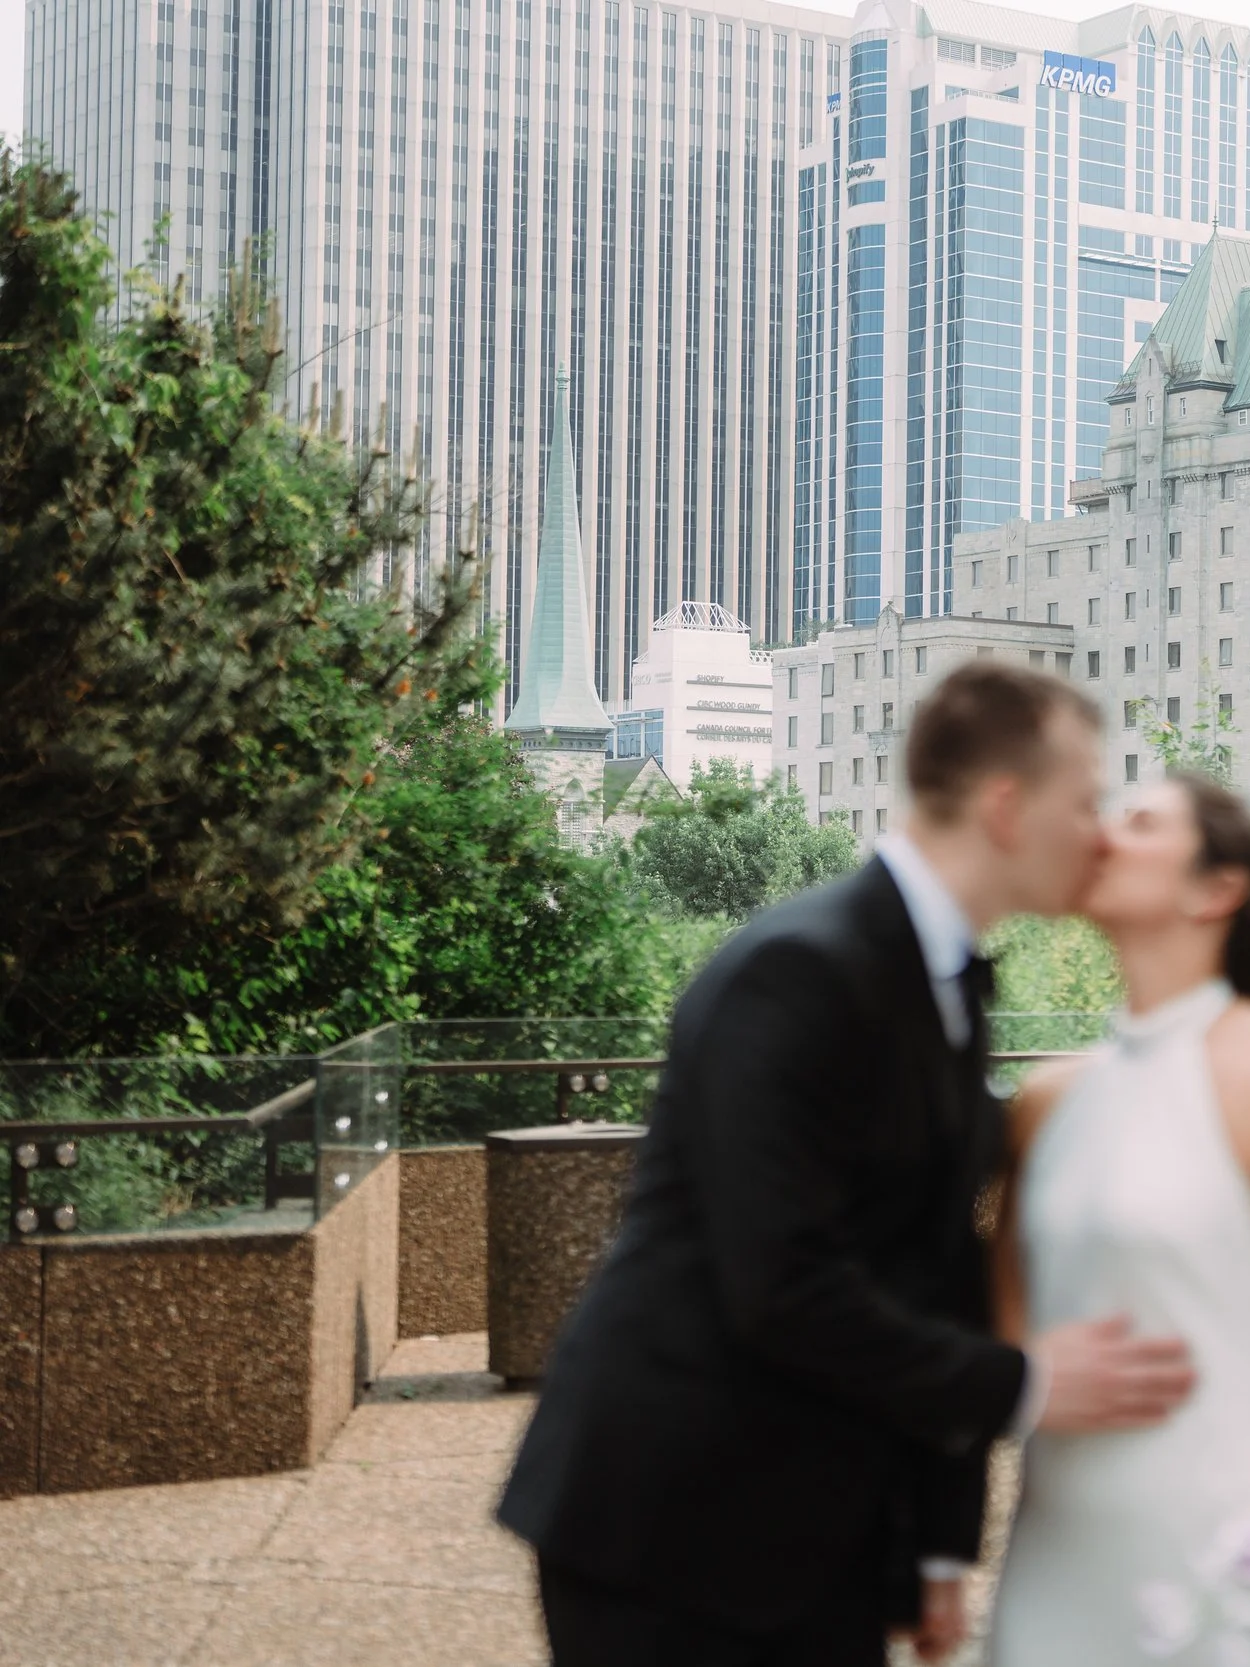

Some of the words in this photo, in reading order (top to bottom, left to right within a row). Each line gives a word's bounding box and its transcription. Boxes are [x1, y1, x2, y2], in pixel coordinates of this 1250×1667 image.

[1040, 64, 1112, 97] KPMG
[697, 674, 725, 682] SHOPIFY
[714, 701, 736, 710] WOOD
[697, 724, 723, 733] CANADA
[724, 725, 752, 734] COUNCIL
